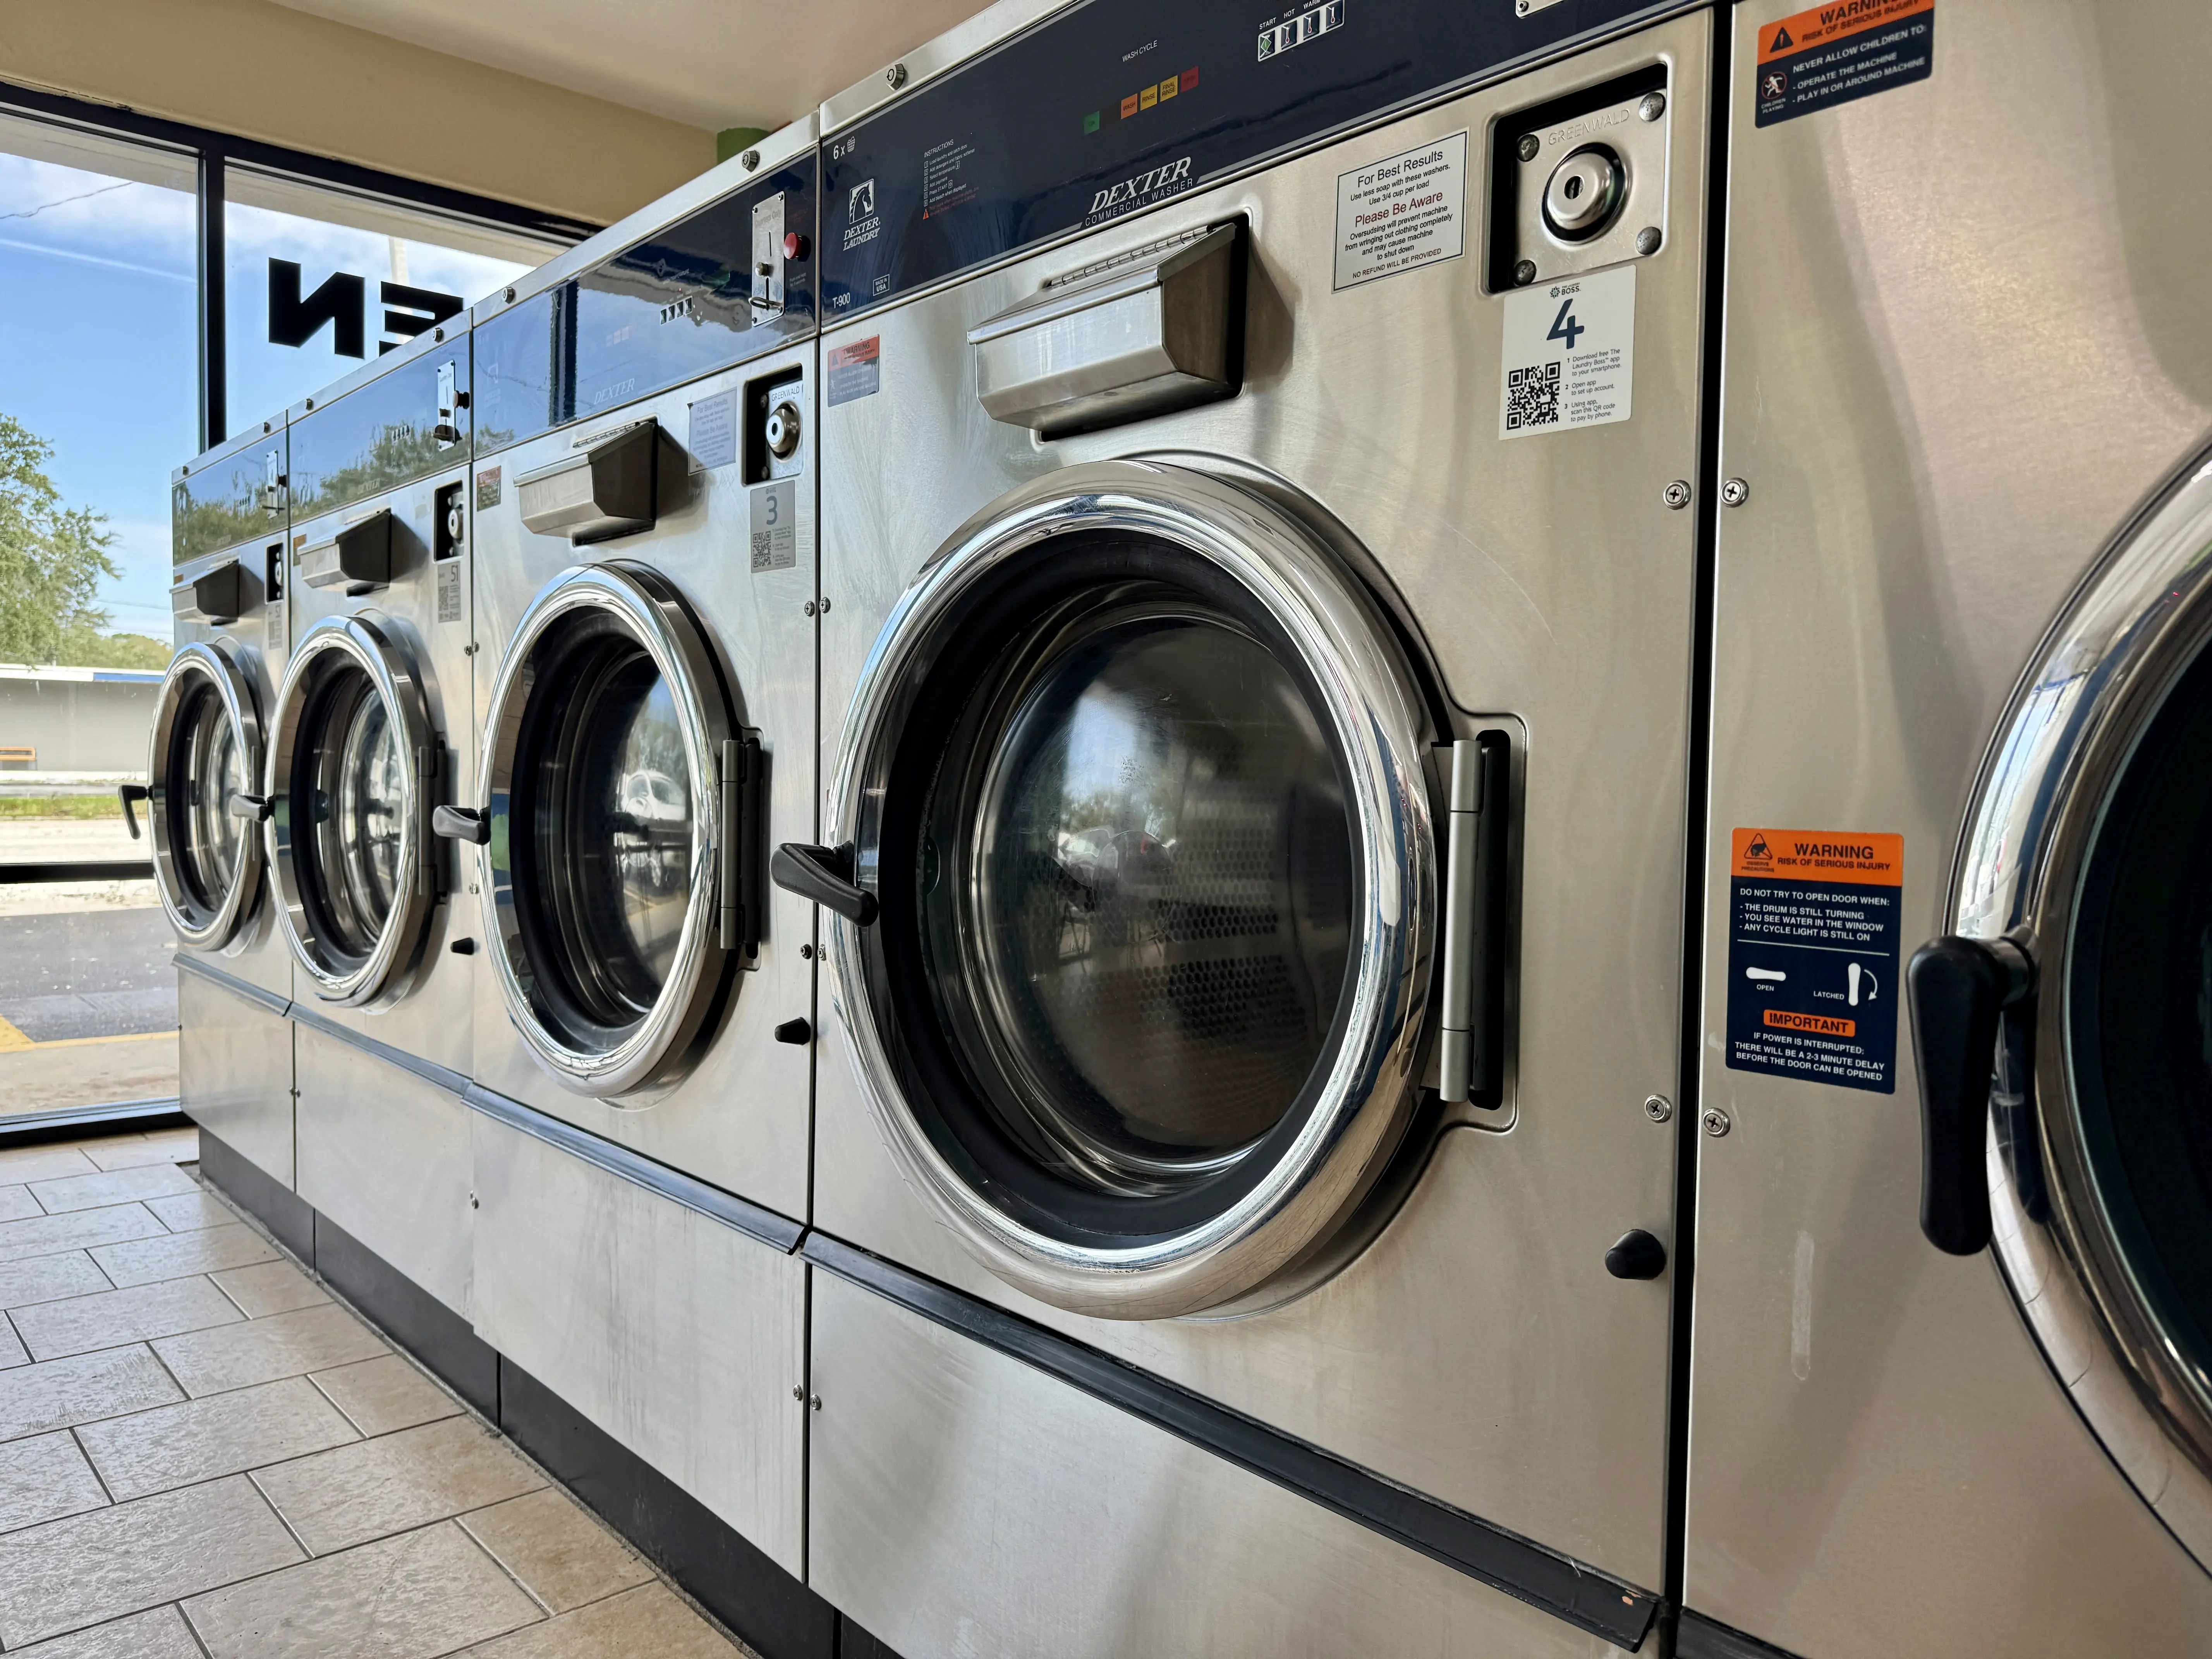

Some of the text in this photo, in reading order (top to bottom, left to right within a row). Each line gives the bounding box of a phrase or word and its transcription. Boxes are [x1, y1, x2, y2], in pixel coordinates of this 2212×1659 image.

[1284, 9, 1295, 18] HOT
[1820, 0, 1896, 25] WARNI
[1259, 17, 1276, 30] START
[1122, 40, 1157, 62] WASH CYCLE
[1793, 24, 1927, 73] NEVER ALLOW CHILDREN TO:
[1797, 52, 1896, 89] OPERATE THE MACHINE
[1797, 57, 1924, 102] PLAY IN OR AROUND MACHINE
[1162, 87, 1176, 97] RINSE
[1163, 81, 1175, 91] FINAL
[1123, 102, 1135, 111] WASH
[1142, 93, 1155, 103] RINSE
[1548, 108, 1630, 145] GREENWALD
[833, 145, 839, 160] 6
[924, 139, 953, 158] INSTRUCTIONS
[1358, 151, 1443, 187] For Best Results
[1376, 184, 1390, 192] soap
[1391, 178, 1403, 187] with
[1405, 173, 1421, 183] these
[1423, 164, 1450, 177] washers.
[1088, 156, 1191, 214] DEXTER
[1382, 192, 1391, 201] 3/4
[1405, 185, 1415, 195] per
[1416, 179, 1429, 190] load
[1085, 178, 1193, 227] COMMERCIAL WASHER
[1355, 192, 1443, 227] Please Be Aware
[843, 217, 879, 240] DEXTER
[1345, 243, 1357, 251] from
[1359, 235, 1382, 247] wringing
[1395, 224, 1418, 235] clothing
[1420, 213, 1453, 228] completely
[1350, 206, 1448, 240] Oversudsing will prevent machine
[843, 227, 880, 251] LAUNDRY
[1362, 230, 1432, 255] and may cause machine
[1362, 264, 1385, 275] REFUND
[1387, 260, 1400, 268] WILL
[1411, 248, 1441, 261] PROVIDED
[1384, 249, 1396, 258] shut
[1398, 245, 1414, 254] down
[876, 283, 886, 292] USA
[833, 292, 850, 308] T-900
[1546, 298, 1584, 349] 4
[1572, 361, 1592, 369] Laundry
[1573, 352, 1597, 362] Download
[594, 378, 635, 405] DEXTER
[771, 386, 800, 401] GREENWALD
[766, 495, 778, 525] 3
[451, 564, 459, 582] 51
[1795, 843, 1873, 859] WARNING
[1814, 859, 1854, 869] SERIOUS
[1856, 862, 1890, 870] INJURY
[1805, 893, 1829, 901] OPEN
[1832, 895, 1857, 903] DOOR
[1860, 896, 1889, 905] WHEN:
[1763, 905, 1787, 913] DRUM
[1800, 907, 1822, 916] STILL
[1825, 909, 1864, 919] TURNING
[1763, 925, 1790, 933] CYCLE
[1793, 927, 1818, 936] LIGHT
[1831, 931, 1854, 939] STILL
[1783, 916, 1812, 925] WATER
[1826, 920, 1842, 928] THE
[1845, 921, 1883, 931] WINDOW
[1814, 991, 1844, 1000] LATCHED
[1769, 1013, 1848, 1033] IMPORTANT
[1763, 1033, 1792, 1044] POWER
[1804, 1039, 1863, 1054] INTERRUPTED:
[1735, 1042, 1761, 1051] THERE
[1764, 1046, 1783, 1054] WILL
[1785, 1049, 1796, 1057] BE
[1806, 1052, 1818, 1060] 2-3
[1821, 1054, 1853, 1065] MINUTE
[1855, 1059, 1884, 1070] DELAY
[1736, 1052, 1767, 1062] BEFORE
[1770, 1057, 1785, 1065] THE
[1788, 1060, 1811, 1069] DOOR
[1813, 1063, 1831, 1072] CAN
[1846, 1069, 1882, 1080] OPENED
